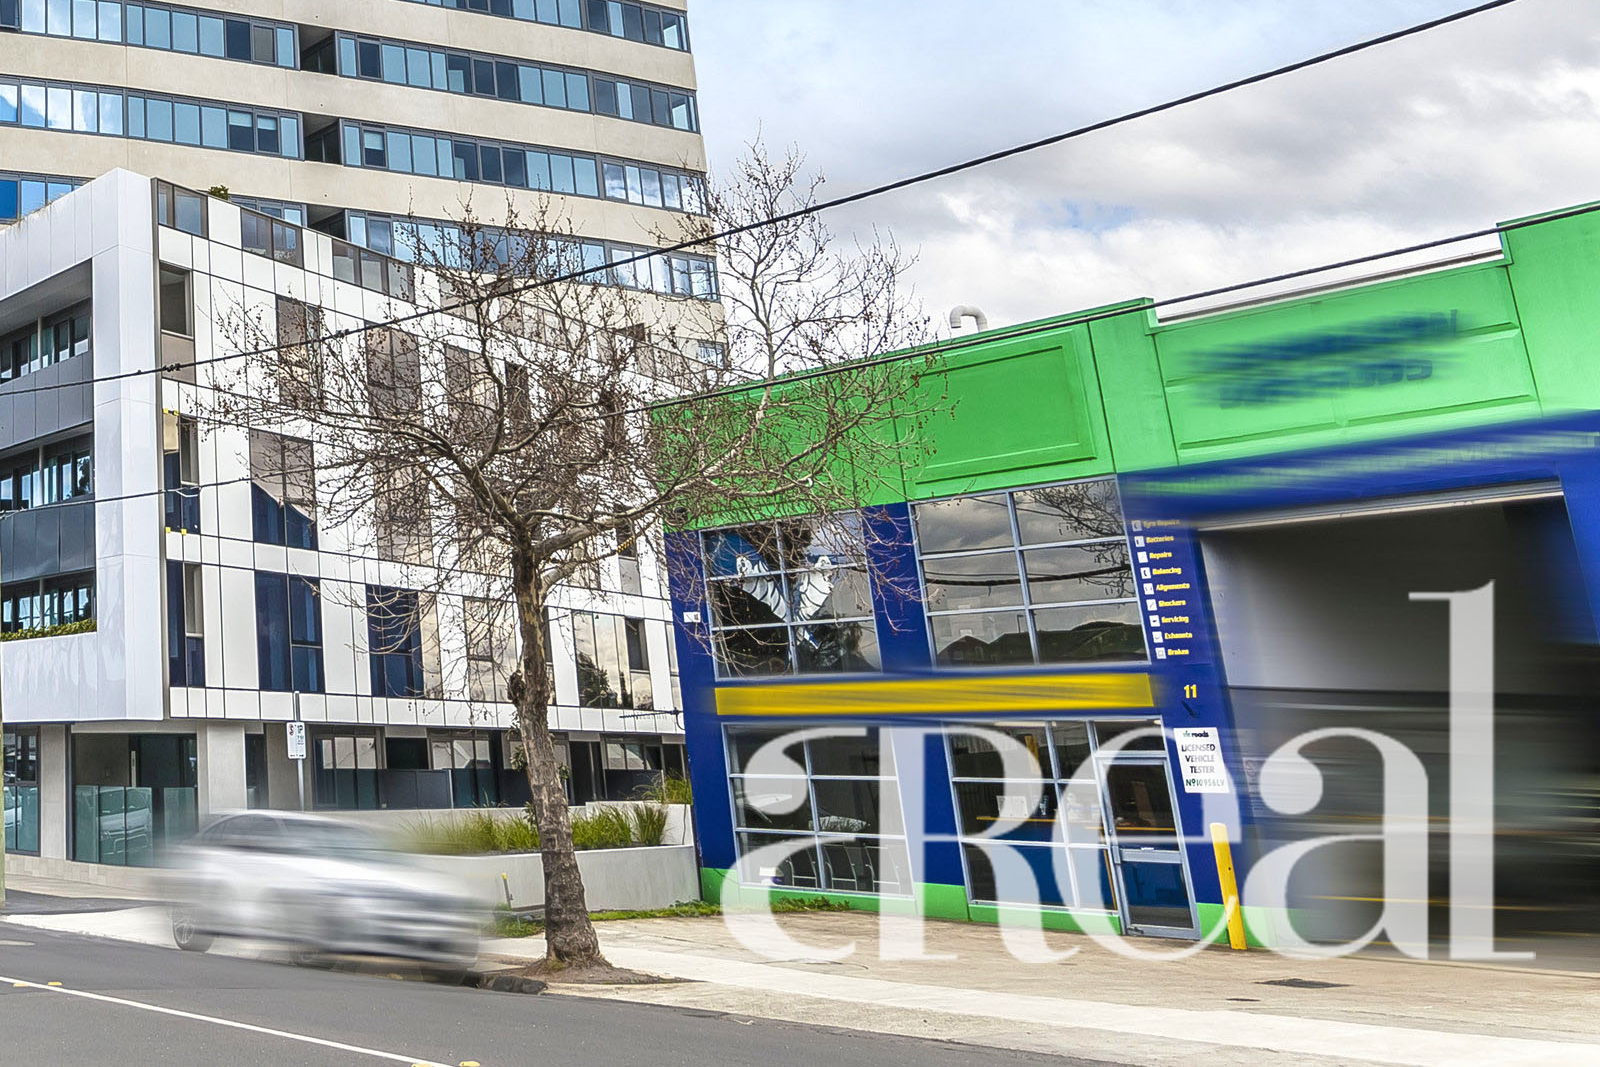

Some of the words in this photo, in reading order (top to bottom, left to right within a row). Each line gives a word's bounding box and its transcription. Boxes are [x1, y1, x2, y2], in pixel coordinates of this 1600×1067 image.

[1152, 567, 1182, 575] Balancing
[1156, 583, 1190, 592] Alignments
[1161, 616, 1189, 624] Servicing
[1164, 632, 1193, 640] Exhausts
[1184, 684, 1197, 699] 11
[1181, 744, 1216, 752] LICENSED
[1185, 755, 1215, 763] VEHICLE
[1190, 765, 1215, 774] TESTER
